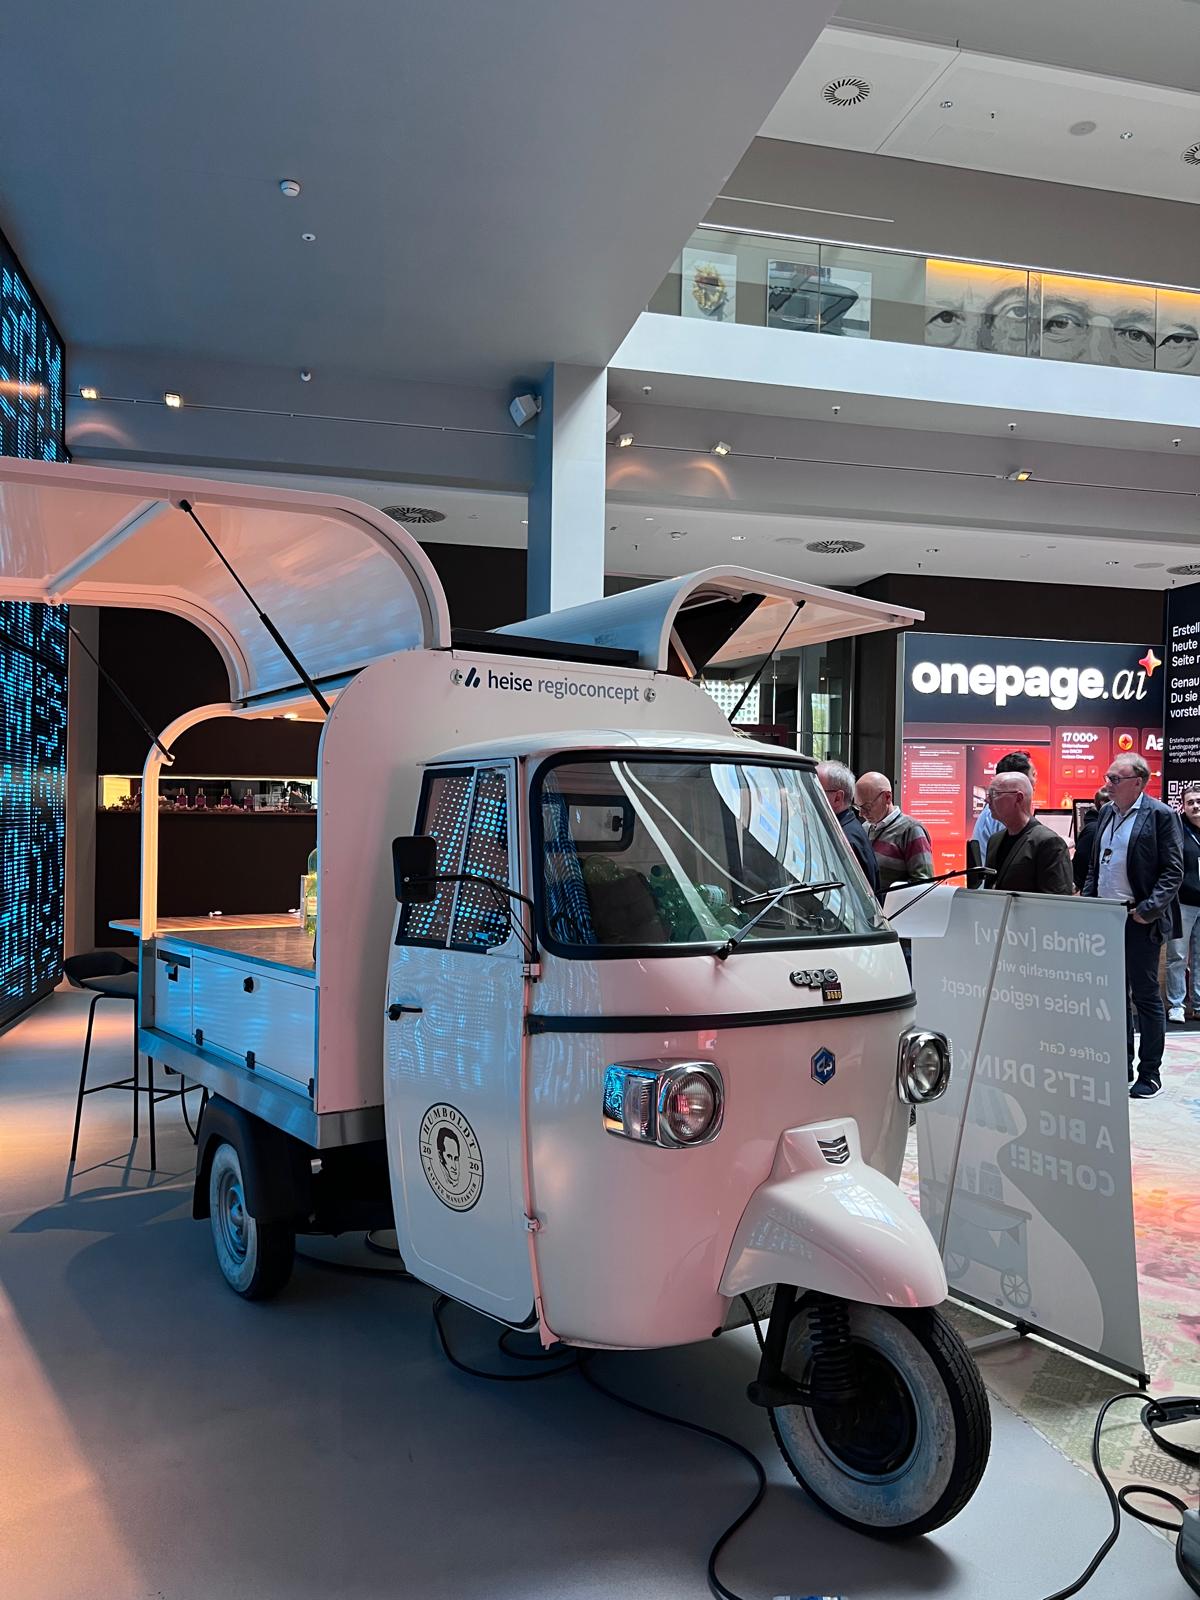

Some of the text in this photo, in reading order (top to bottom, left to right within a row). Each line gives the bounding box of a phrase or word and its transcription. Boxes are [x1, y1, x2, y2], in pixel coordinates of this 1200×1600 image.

[1172, 639, 1198, 653] heute
[1172, 655, 1195, 667] Seite
[488, 670, 639, 704] heise regioconcept
[911, 660, 1148, 711] onepage.ai
[1171, 677, 1200, 689] Genau
[1170, 690, 1198, 704] Du sie
[790, 968, 838, 988] ape
[423, 1107, 476, 1149] HUMBOLDT
[423, 1145, 432, 1155] 20
[469, 1161, 480, 1171] 20
